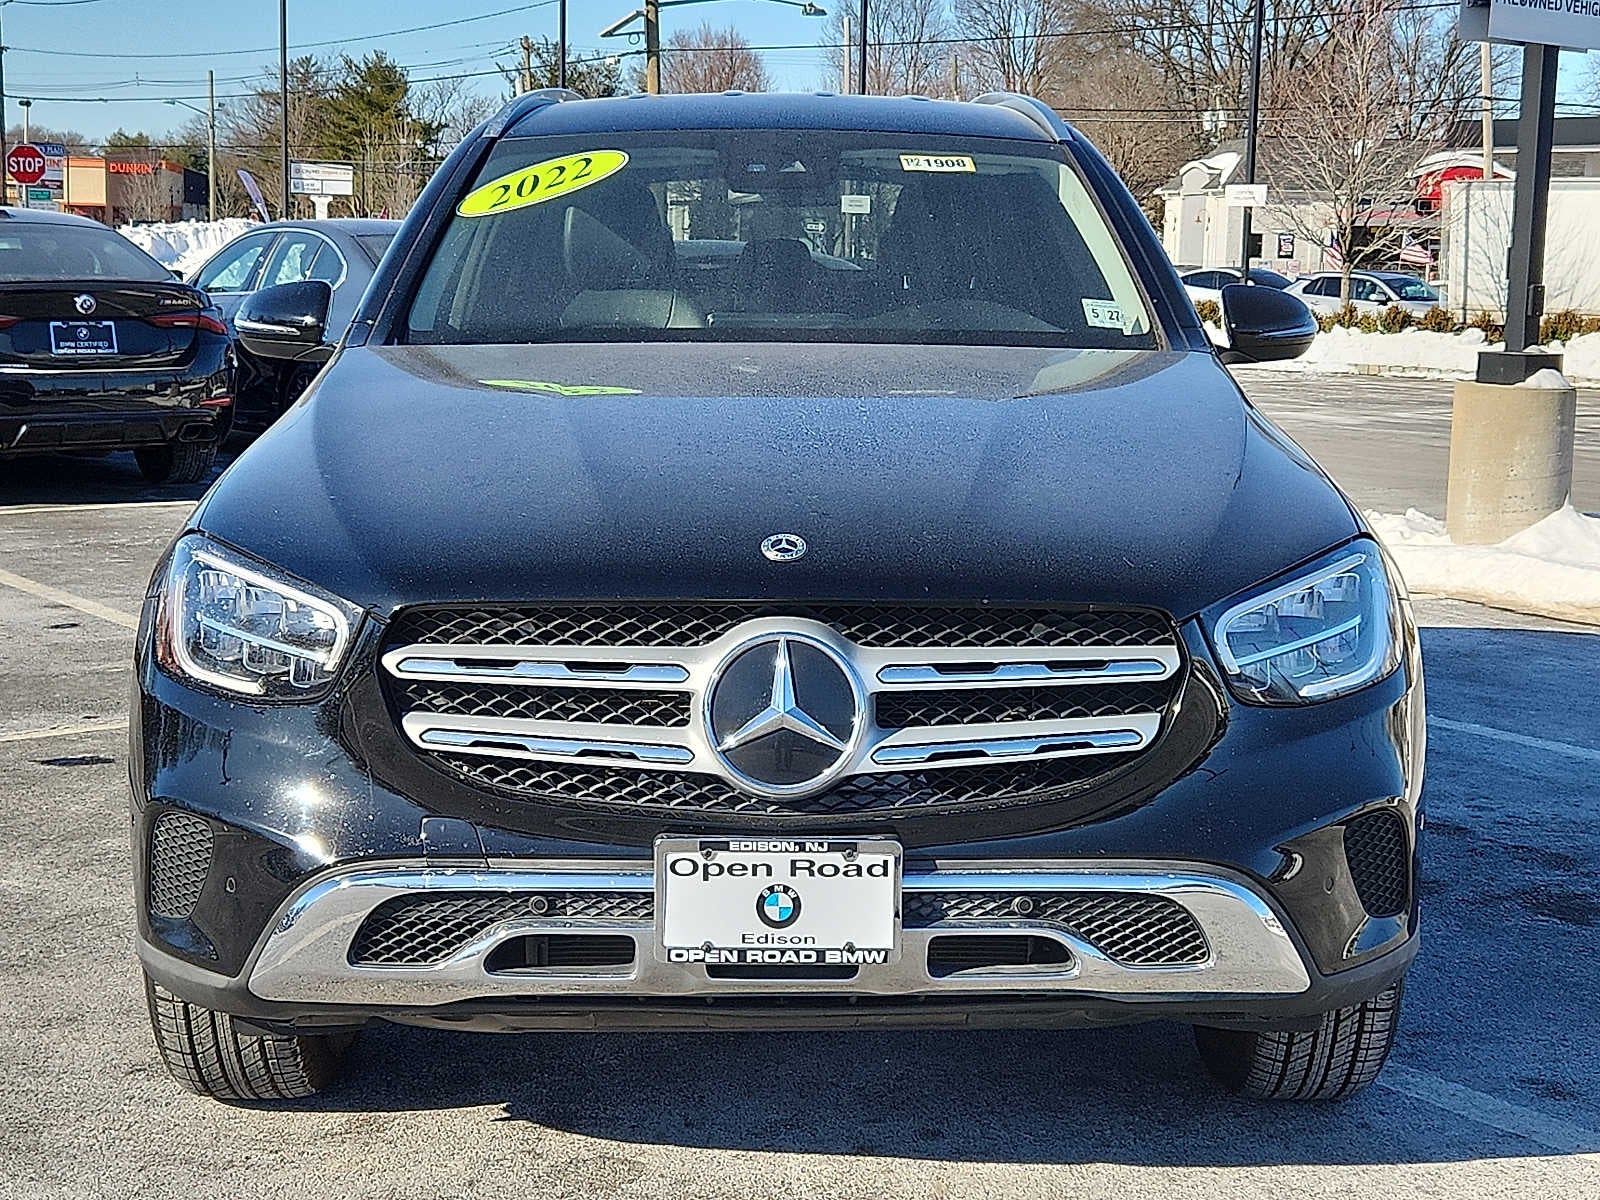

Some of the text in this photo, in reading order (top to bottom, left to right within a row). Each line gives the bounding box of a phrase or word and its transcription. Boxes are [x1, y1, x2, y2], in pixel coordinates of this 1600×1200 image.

[1494, 0, 1600, 16] WNED VEHIC
[9, 157, 44, 173] STOP
[488, 157, 593, 210] 2022
[1091, 308, 1120, 321] 5 27
[729, 841, 828, 852] EDISON, NJ
[669, 858, 889, 881] Open Road
[762, 885, 797, 898] BMW
[741, 933, 816, 945] Edison
[669, 949, 886, 963] OPEN ROAD BMW
